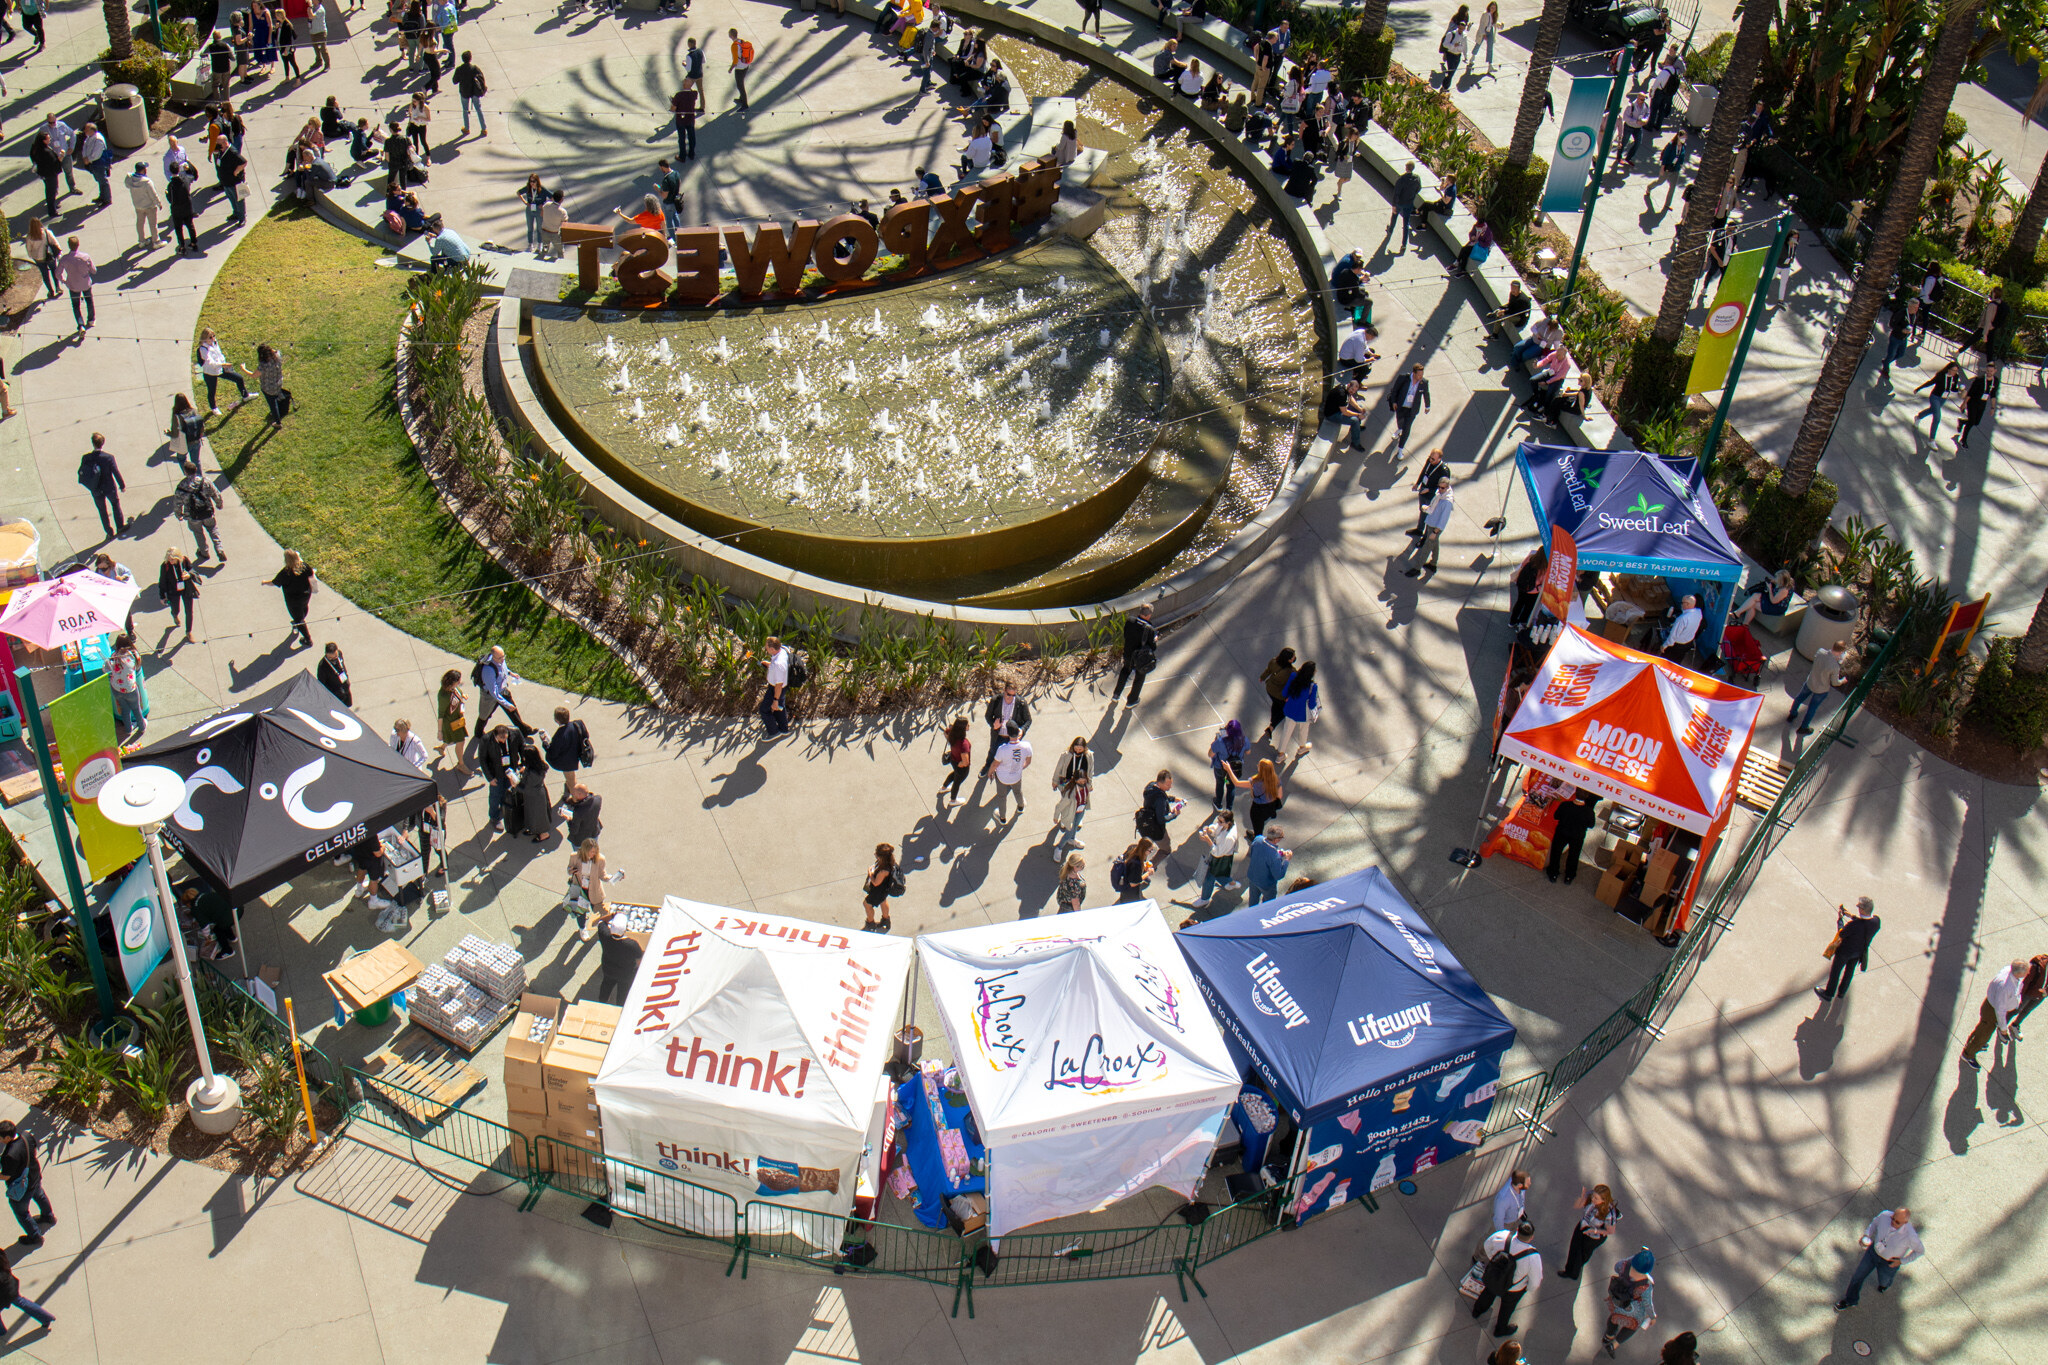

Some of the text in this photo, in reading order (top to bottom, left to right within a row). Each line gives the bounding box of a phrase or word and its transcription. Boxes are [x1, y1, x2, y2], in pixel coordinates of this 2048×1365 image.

[1557, 455, 1591, 513] SweetLeaf
[1598, 512, 1690, 538] SweetLeaf
[1557, 553, 1573, 593] MOON
[1582, 558, 1624, 569] WORLD'S
[1625, 561, 1649, 570] BEST
[1650, 563, 1688, 574] TASTING
[1689, 567, 1721, 577] STEVIA
[58, 610, 98, 632] ROAR
[1540, 664, 1571, 707] CHEESE
[1568, 662, 1604, 708] MOON
[1582, 719, 1663, 766] MOON
[1681, 705, 1715, 757] MOON
[1700, 720, 1733, 770] CHEESE
[81, 769, 105, 785] Natural
[82, 772, 111, 790] Products
[1576, 742, 1654, 783] CHEESE
[1520, 749, 1568, 775] CRANK
[1573, 771, 1591, 784] UP
[1597, 780, 1623, 797] THE
[1629, 793, 1687, 822] CRUNCH
[305, 822, 367, 862] CELSIUS
[344, 833, 367, 849] LIVE FIT
[1503, 823, 1530, 839] MOON
[714, 916, 852, 951] think!
[1259, 896, 1347, 930] Lifeway
[1380, 908, 1443, 975] Lifeway
[633, 929, 703, 1036] think!
[1246, 951, 1309, 1030] Lifeway
[822, 957, 882, 1074] think!
[1347, 1002, 1432, 1046] Lifeway
[664, 1036, 812, 1100] think!
[1217, 1006, 1227, 1020] to
[1231, 1022, 1263, 1066] Healthy
[1261, 1066, 1278, 1090] Gut
[1346, 1049, 1476, 1108] Hello to a Healthy Gut
[1367, 1126, 1398, 1144] Booth
[655, 1141, 750, 1177] think!
